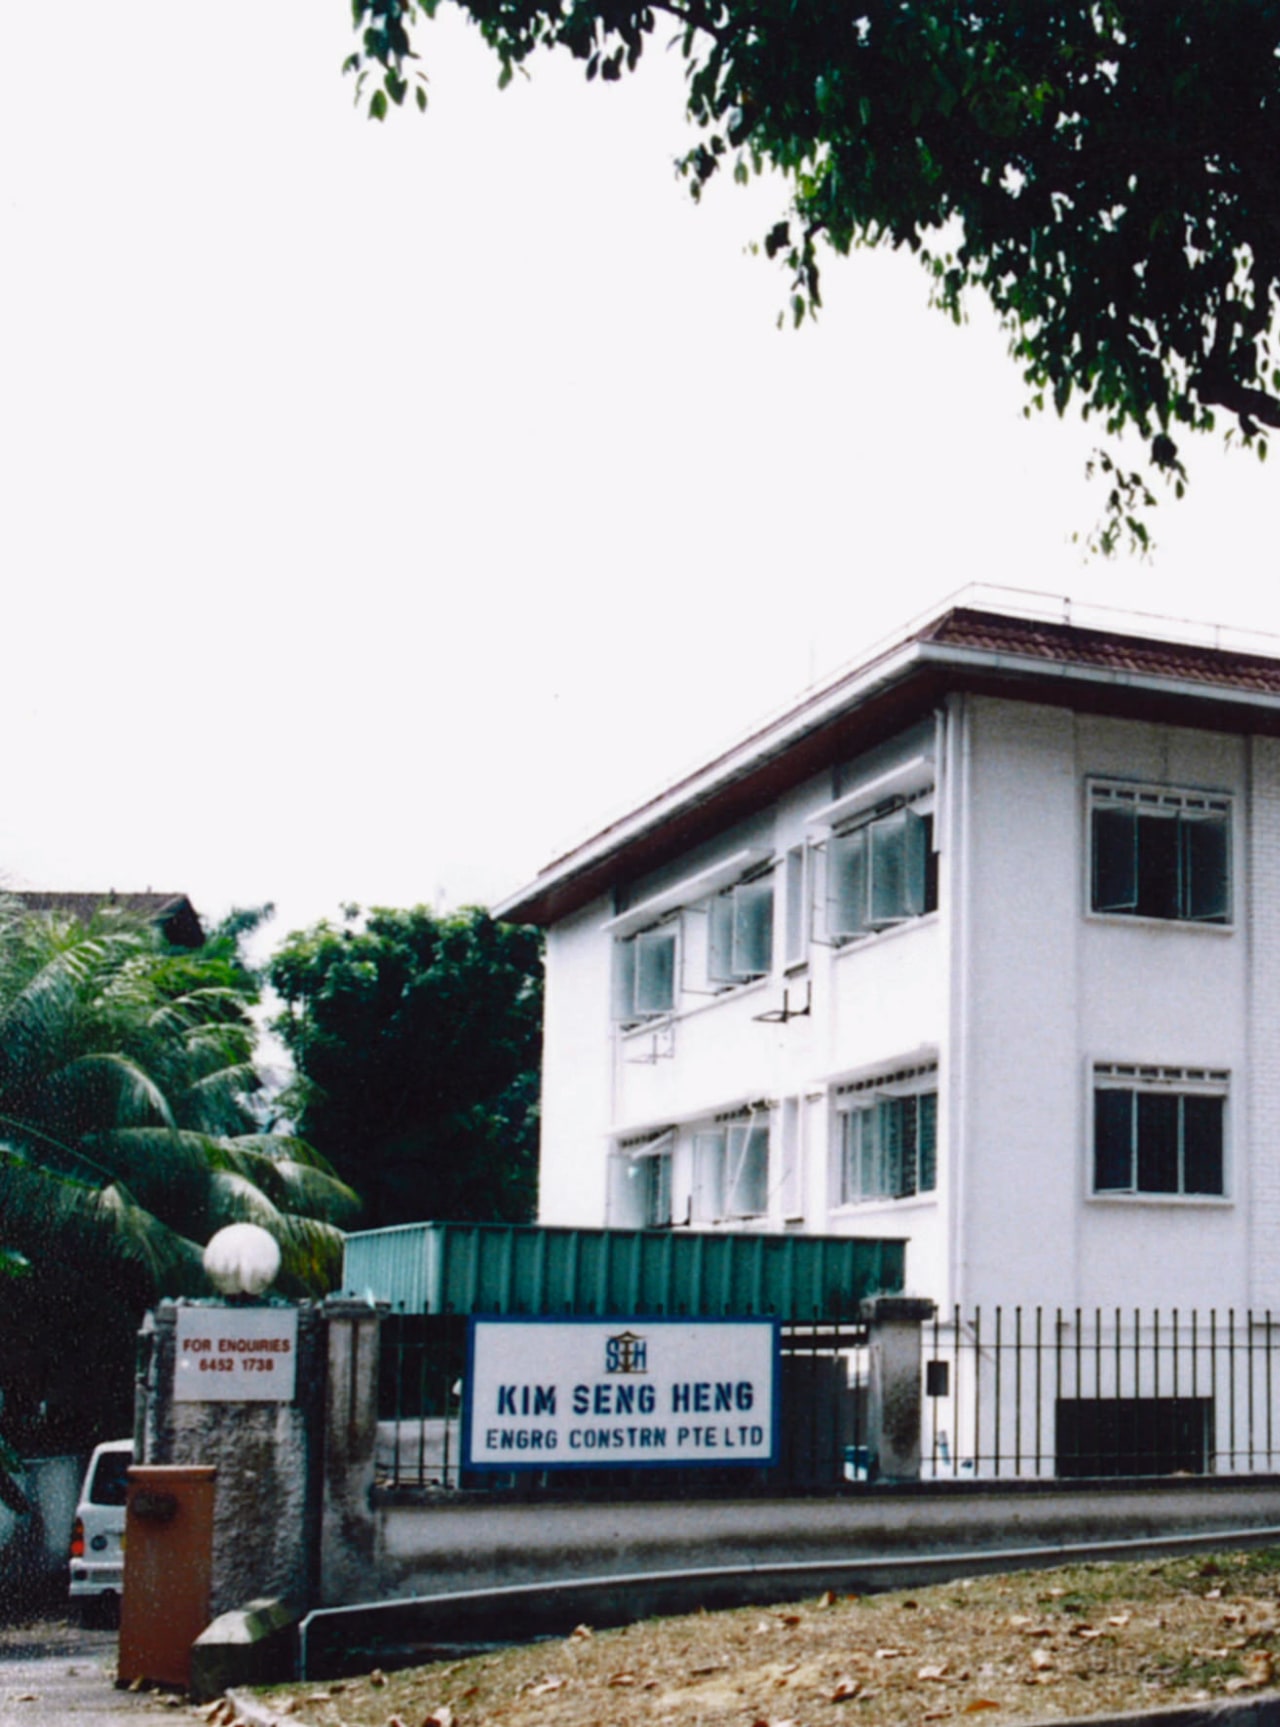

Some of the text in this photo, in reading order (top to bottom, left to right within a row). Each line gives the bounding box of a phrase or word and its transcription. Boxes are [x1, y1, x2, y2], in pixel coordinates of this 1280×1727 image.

[183, 1338, 291, 1352] FOR ENQUIRIES
[199, 1358, 274, 1372] 6452 1738
[497, 1381, 754, 1415] KIM SENG HENG
[486, 1426, 764, 1449] ENGRG CONSTRN PTE LTD
